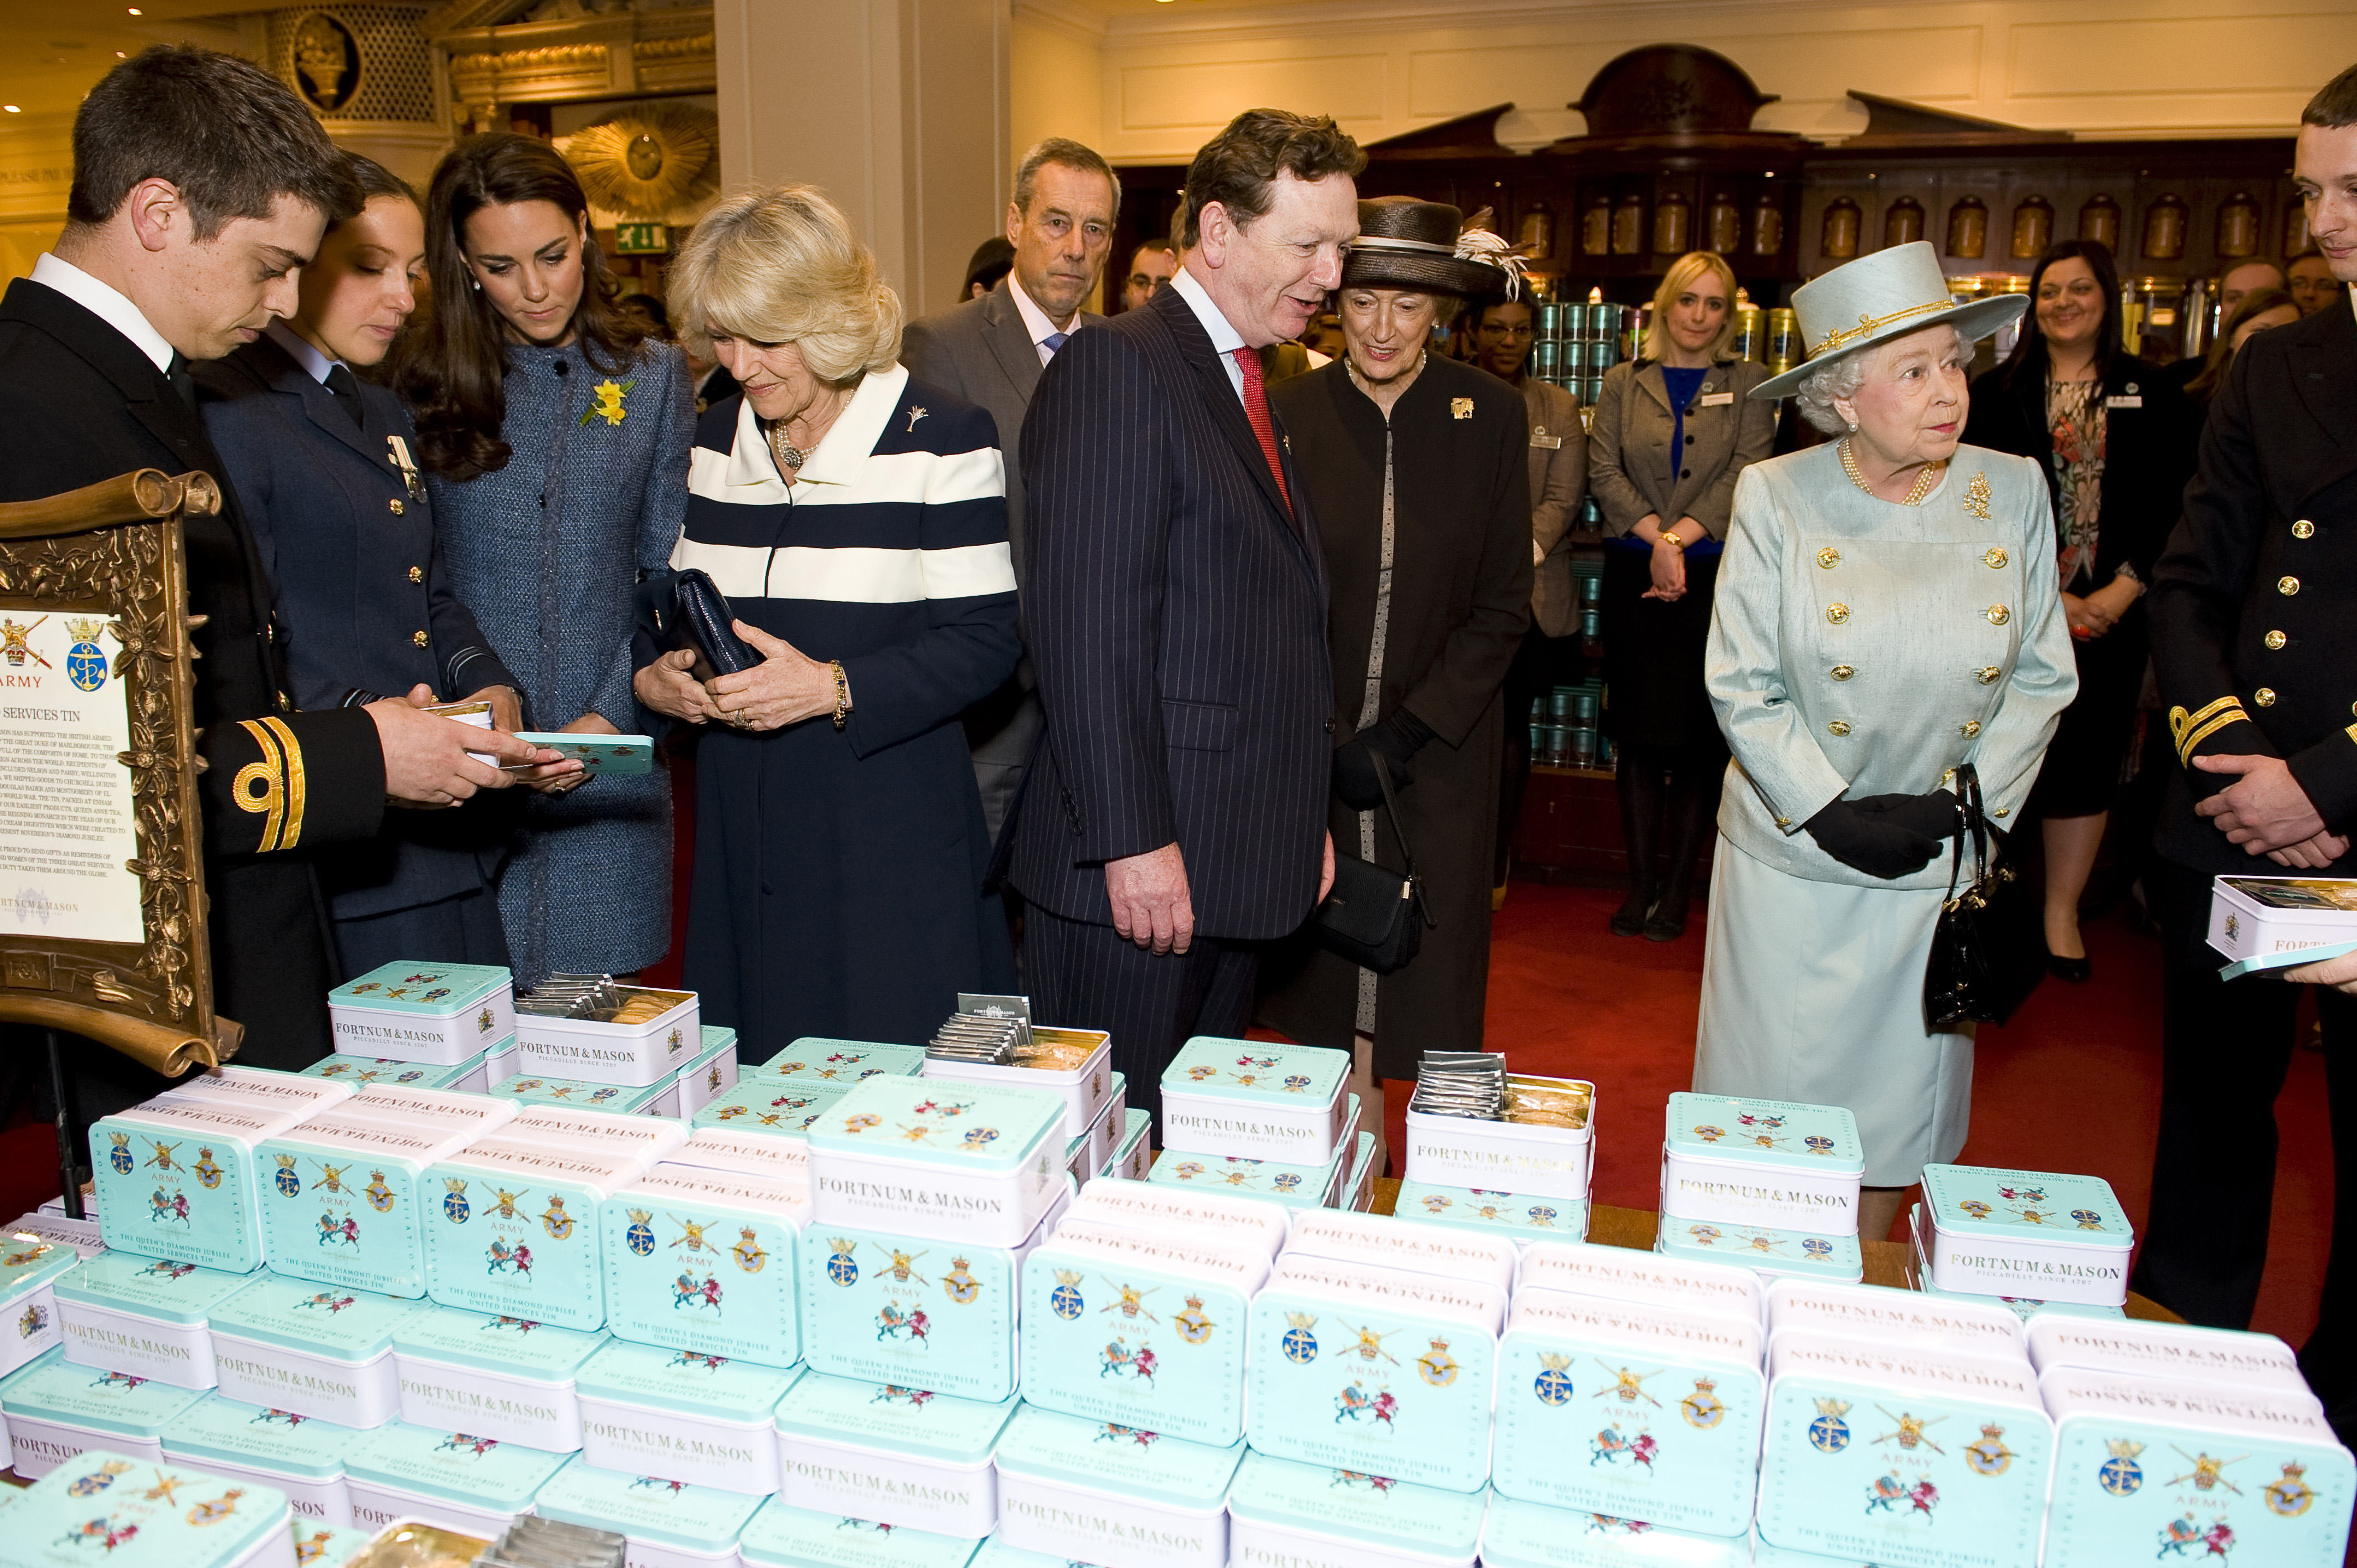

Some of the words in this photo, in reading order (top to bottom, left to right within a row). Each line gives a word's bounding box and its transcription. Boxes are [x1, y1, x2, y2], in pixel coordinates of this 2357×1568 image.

[3, 707, 58, 721] SERVICES
[60, 710, 80, 721] TIN
[38, 901, 43, 909] &
[46, 902, 78, 912] MASON
[336, 1023, 392, 1038] FORTNUM
[394, 1030, 402, 1039] &
[404, 1030, 445, 1043] MASON
[520, 1041, 579, 1057] FORTNUM
[582, 1048, 590, 1058] &
[592, 1050, 635, 1062] MASON
[189, 1076, 260, 1091] FORTNUM
[259, 1085, 271, 1093] &
[270, 1086, 324, 1100] MASON
[348, 1094, 424, 1109] FORTNUM
[431, 1105, 490, 1118] MASON
[1171, 1114, 1246, 1133] FORTNUM
[1250, 1124, 1260, 1134] &
[1264, 1125, 1317, 1140] MASON
[1418, 1144, 1499, 1164] FORTNUM
[1503, 1155, 1514, 1166] &
[1517, 1156, 1575, 1173] MASON
[152, 1173, 180, 1184] ARMY
[319, 1196, 350, 1208] ARMY
[819, 1177, 913, 1204] FORTNUM
[918, 1191, 930, 1205] &
[935, 1193, 1002, 1214] MASON
[1680, 1179, 1767, 1200] FORTNUM
[1772, 1190, 1783, 1201] &
[1787, 1192, 1849, 1208] MASON
[491, 1223, 524, 1235] ARMY
[120, 1234, 133, 1242] THE
[136, 1236, 164, 1247] QUEEN'S
[167, 1242, 202, 1254] DIAMOND
[203, 1248, 231, 1259] JUBILEE
[138, 1244, 164, 1254] UNITED
[167, 1249, 199, 1261] SERVICES
[301, 1260, 332, 1272] QUEEN'S
[334, 1267, 370, 1278] DIAMOND
[373, 1274, 402, 1285] JUBILEE
[677, 1255, 713, 1267] ARMY
[1951, 1254, 2039, 1273] FORTNUM
[2043, 1263, 2055, 1274] &
[2059, 1263, 2121, 1280] MASON
[304, 1269, 332, 1280] UNITED
[334, 1275, 368, 1286] SERVICES
[1539, 1258, 1647, 1282] FORTNUM
[1653, 1275, 1667, 1285] &
[1672, 1277, 1749, 1297] MASON
[449, 1287, 464, 1296] THE
[467, 1290, 500, 1302] QUEEN'S
[503, 1297, 543, 1309] DIAMOND
[546, 1304, 577, 1316] JUBILEE
[882, 1286, 921, 1298] ARMY
[469, 1299, 500, 1310] UNITED
[502, 1305, 539, 1317] SERVICES
[1788, 1298, 1905, 1322] FORTNUM
[1911, 1314, 1925, 1324] &
[1931, 1316, 2013, 1337] MASON
[60, 1319, 127, 1347] FORTNUM
[130, 1336, 140, 1348] &
[142, 1339, 191, 1360] MASON
[1109, 1321, 1150, 1335] ARMY
[216, 1355, 288, 1383] FORTNUM
[292, 1373, 301, 1385] &
[304, 1375, 356, 1399] MASON
[1345, 1365, 1391, 1379] ARMY
[401, 1379, 481, 1407] FORTNUM
[485, 1397, 496, 1410] &
[499, 1399, 558, 1421] MASON
[1603, 1407, 1651, 1421] ARMY
[11, 1435, 83, 1458] FORTNUM
[583, 1420, 671, 1449] FORTNUM
[675, 1438, 687, 1452] &
[691, 1440, 754, 1463] MASON
[1880, 1453, 1933, 1468] ARMY
[785, 1459, 881, 1490] FORTNUM
[885, 1479, 897, 1493] &
[902, 1482, 970, 1506] MASON
[2175, 1495, 2231, 1510] ARMY
[1006, 1498, 1107, 1534] FORTNUM
[1112, 1523, 1125, 1536] &
[1131, 1525, 1203, 1552] MASON
